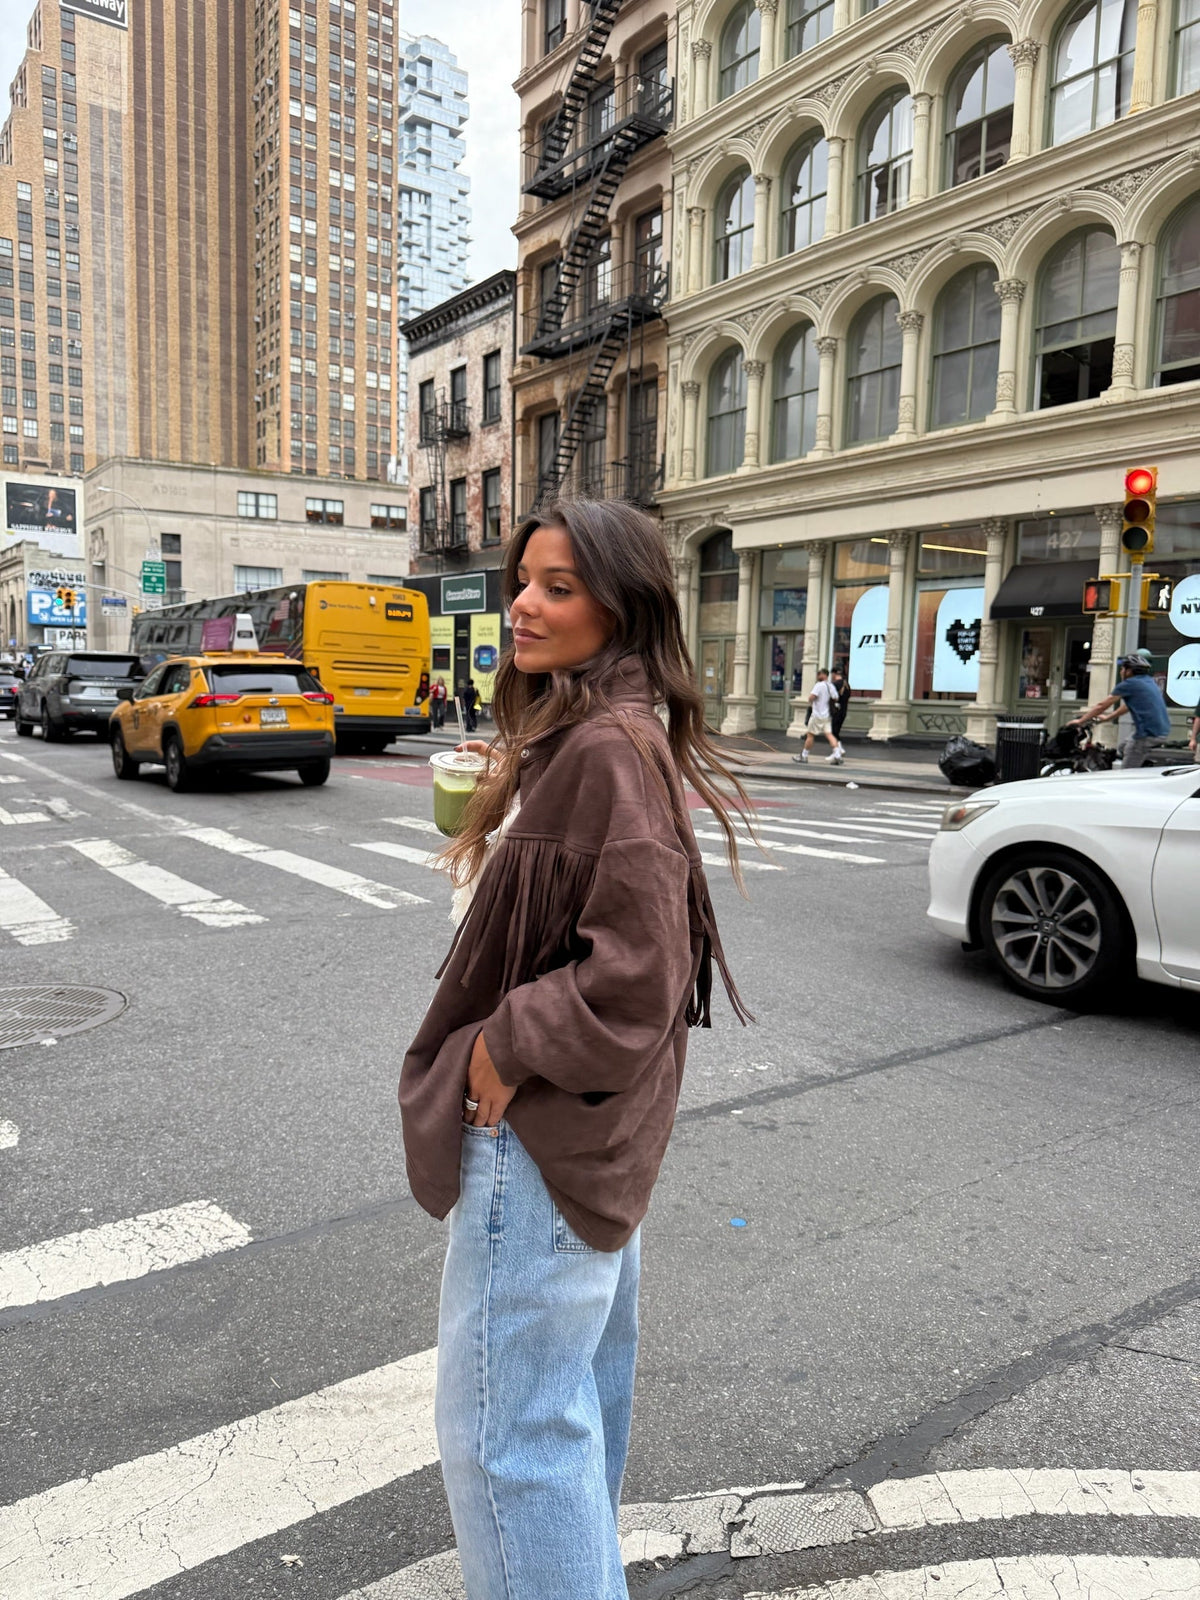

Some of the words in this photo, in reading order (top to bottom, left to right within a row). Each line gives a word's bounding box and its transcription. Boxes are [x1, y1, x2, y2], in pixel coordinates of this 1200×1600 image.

[85, 0, 125, 18] way
[1046, 531, 1082, 549] 427
[1030, 606, 1045, 616] 427
